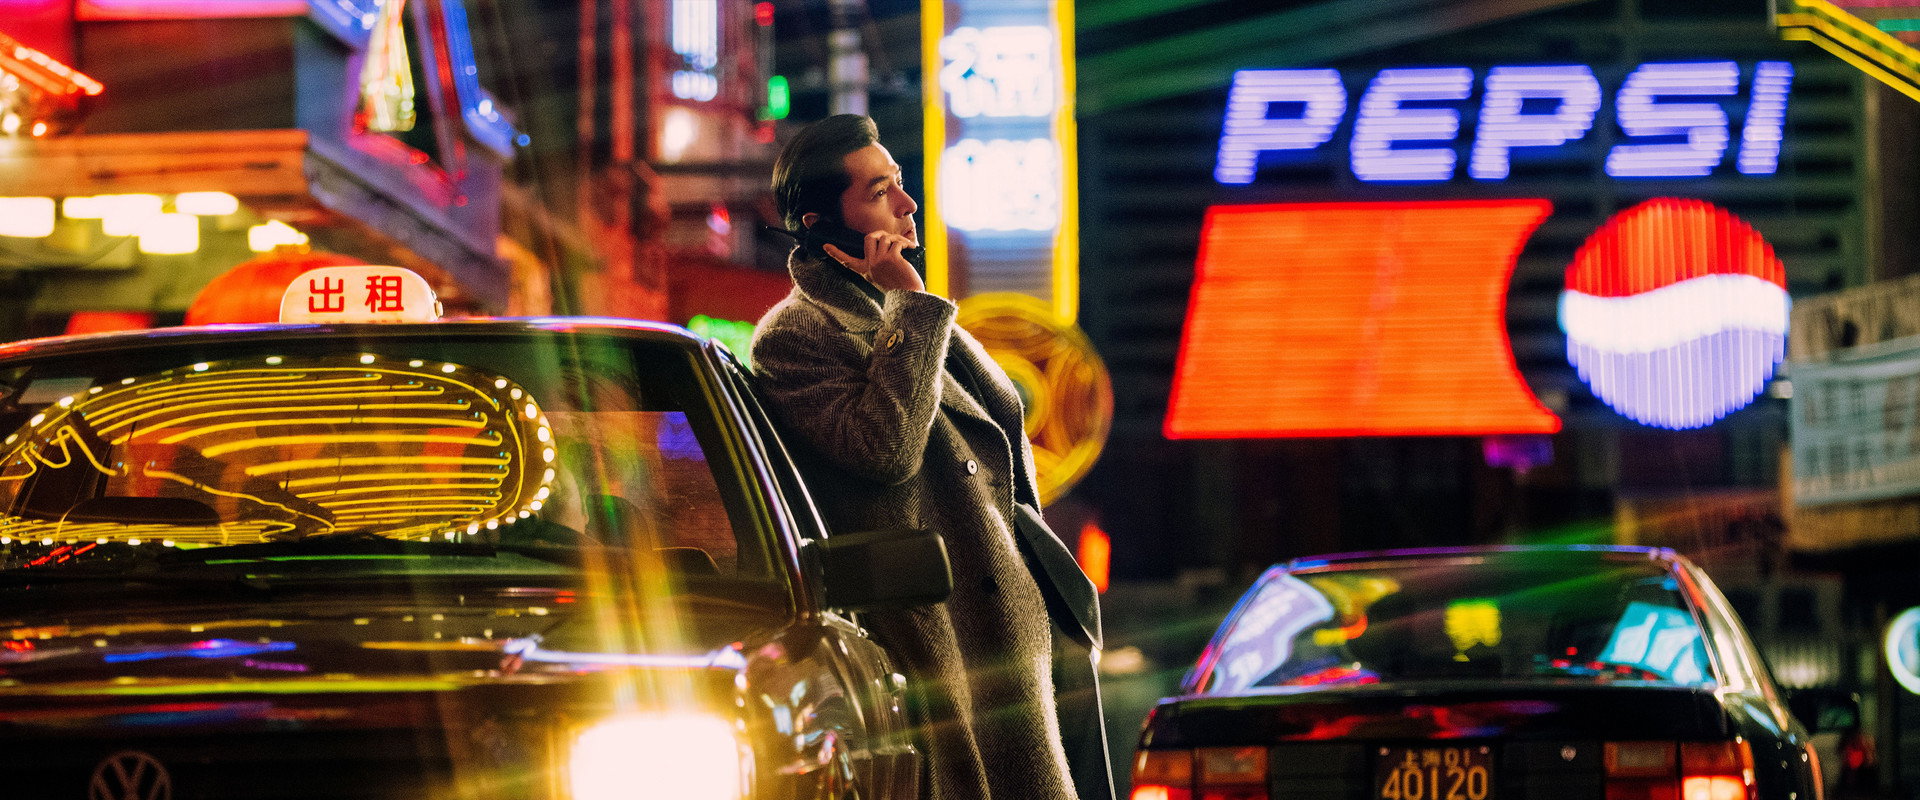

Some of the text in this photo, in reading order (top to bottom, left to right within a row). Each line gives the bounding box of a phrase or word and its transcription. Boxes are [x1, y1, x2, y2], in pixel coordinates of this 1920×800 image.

[1213, 61, 1794, 184] PEPSI
[308, 275, 404, 313] 出租
[1382, 766, 1488, 800] 40120
